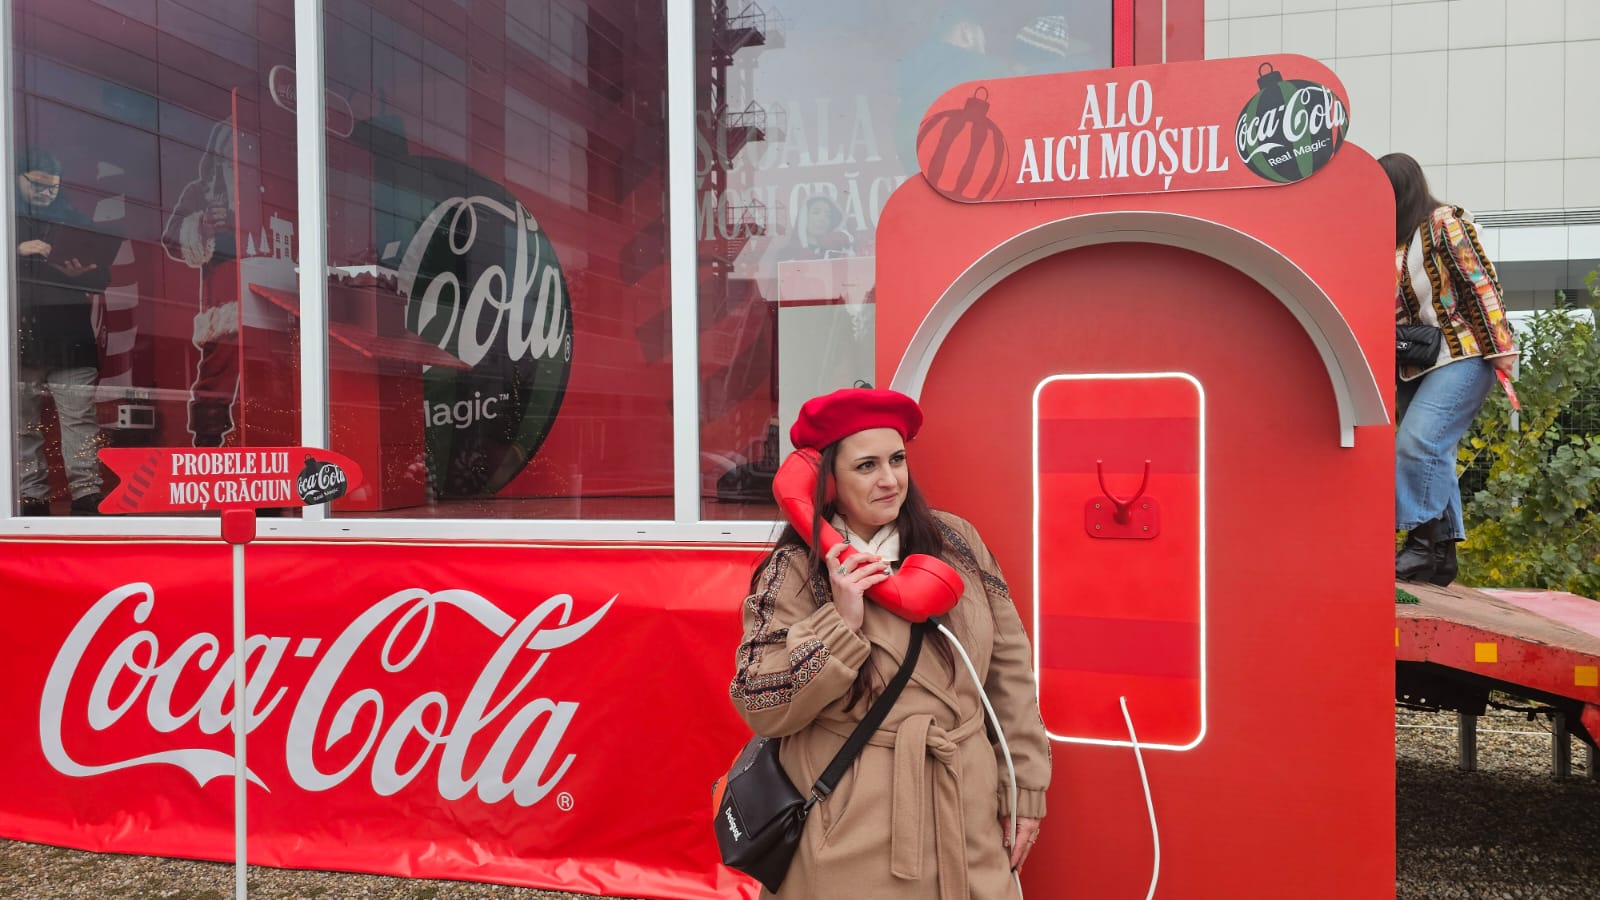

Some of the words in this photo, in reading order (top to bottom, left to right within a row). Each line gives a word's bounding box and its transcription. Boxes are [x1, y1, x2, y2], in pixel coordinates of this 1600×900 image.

[1078, 79, 1164, 131] ALO,
[1235, 85, 1346, 163] Coca-Cola
[1016, 133, 1089, 185] AICI
[1099, 125, 1230, 190] MOȘUL
[1268, 151, 1293, 167] Real
[171, 452, 257, 476] PROBELE
[260, 452, 289, 474] LUI
[169, 482, 210, 510] MOȘ
[213, 478, 292, 503] CRĂCIUN
